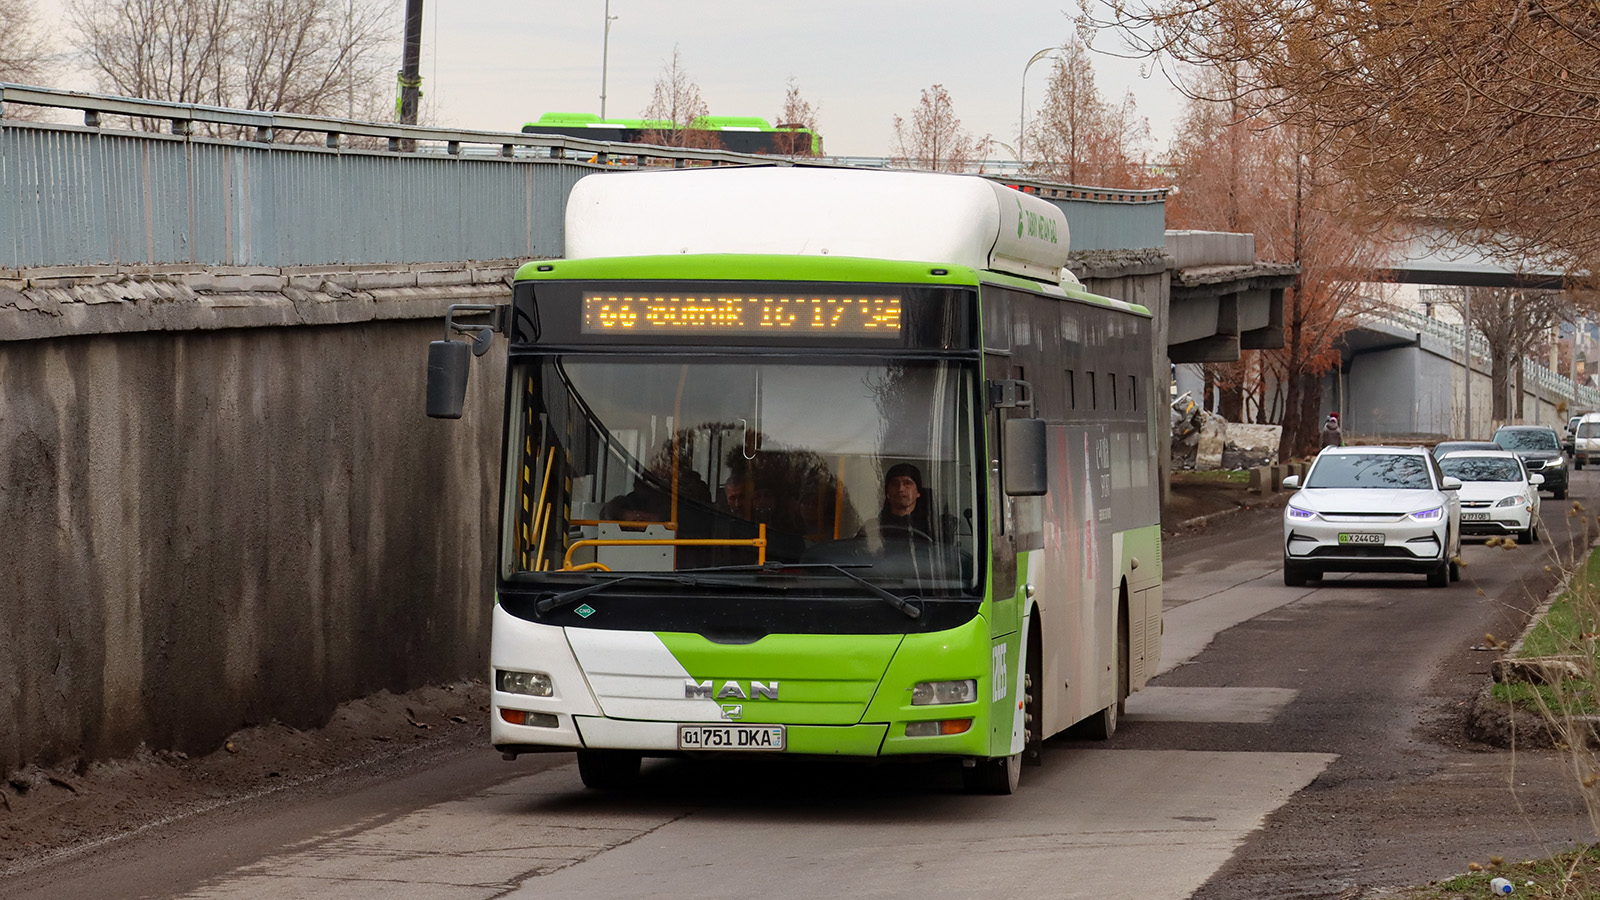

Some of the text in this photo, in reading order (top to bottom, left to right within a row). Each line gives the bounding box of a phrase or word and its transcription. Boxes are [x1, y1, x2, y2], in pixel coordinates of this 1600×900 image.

[599, 303, 636, 327] 66
[685, 680, 779, 700] MAN
[685, 731, 699, 744] 01
[703, 730, 732, 746] 751
[737, 730, 771, 746] DKA
